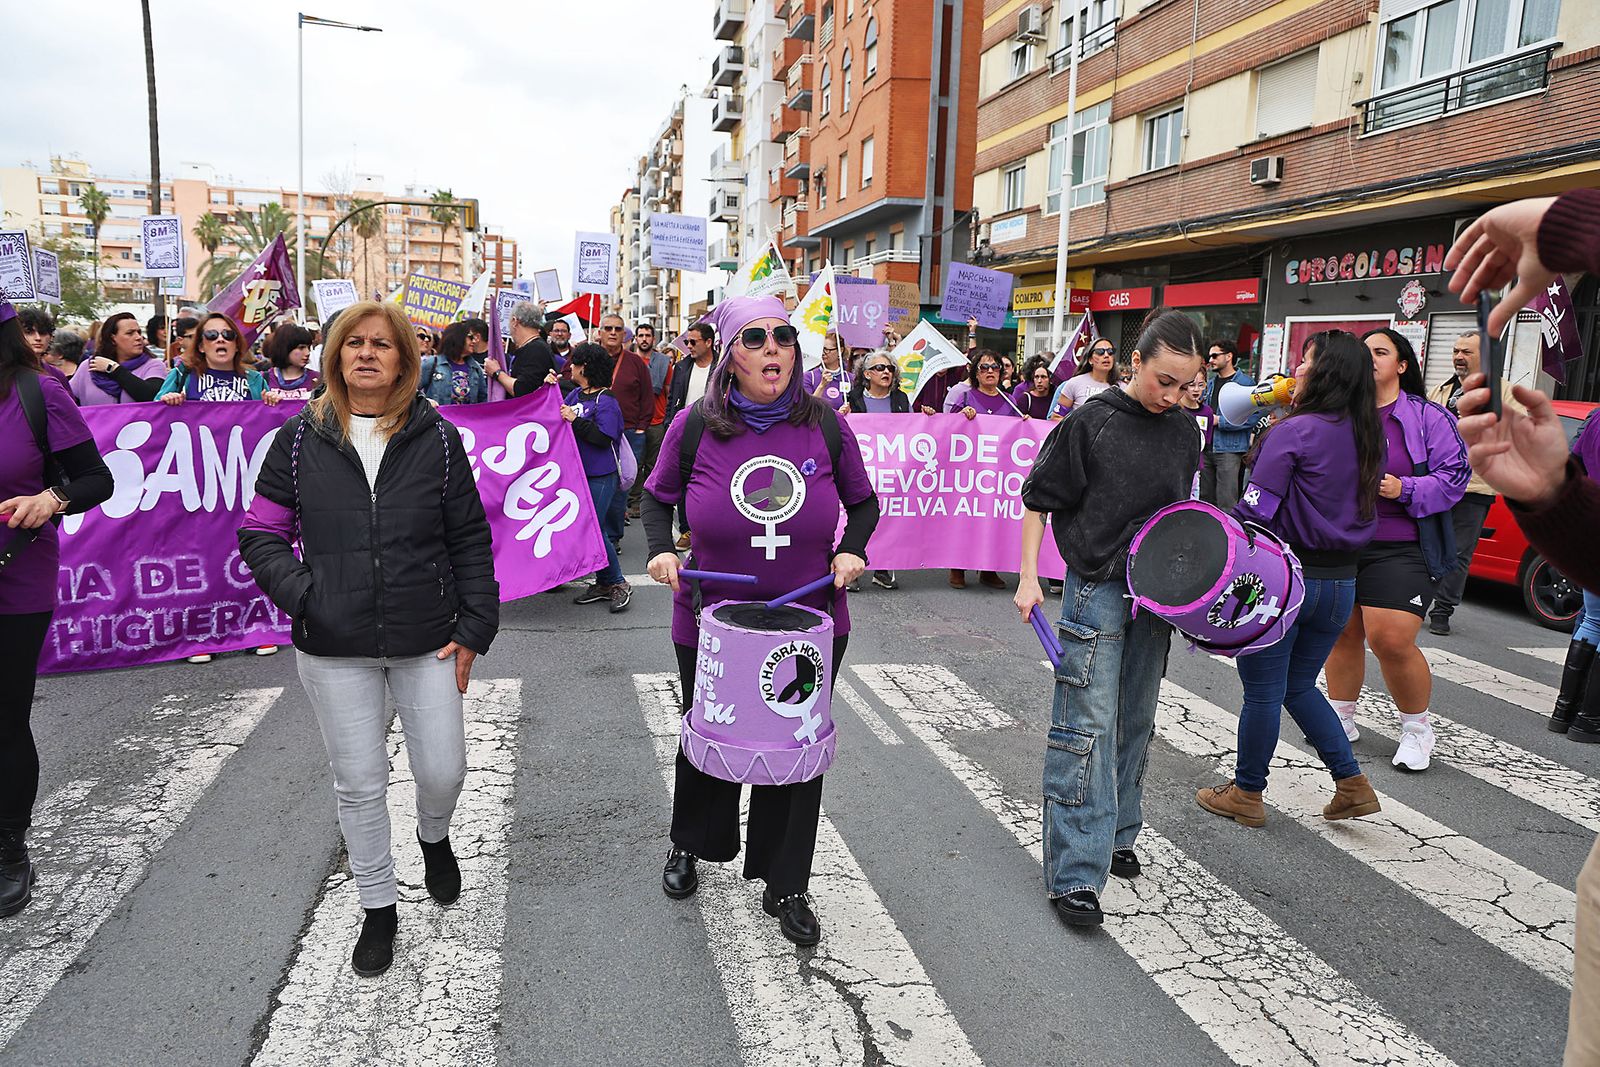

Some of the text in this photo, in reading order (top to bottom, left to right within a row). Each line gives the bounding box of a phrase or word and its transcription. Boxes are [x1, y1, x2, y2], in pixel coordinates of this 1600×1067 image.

[150, 227, 167, 237] 8M
[0, 243, 13, 256] M
[585, 249, 601, 257] 8M
[41, 259, 51, 267] 8M
[1285, 244, 1452, 285] EUROGOLOSIN
[325, 288, 343, 297] 8M
[409, 275, 461, 299] PATRIARCADO
[406, 289, 457, 314] HA DEJADO
[1015, 291, 1043, 304] COMPRO
[1072, 295, 1090, 303] GAES
[1108, 292, 1130, 307] GAES
[959, 306, 982, 315] FALTA
[950, 434, 1000, 463] DE
[954, 497, 986, 517] AL
[141, 558, 202, 595] DE
[762, 641, 824, 701] NO HABRÁ HOGUERA
